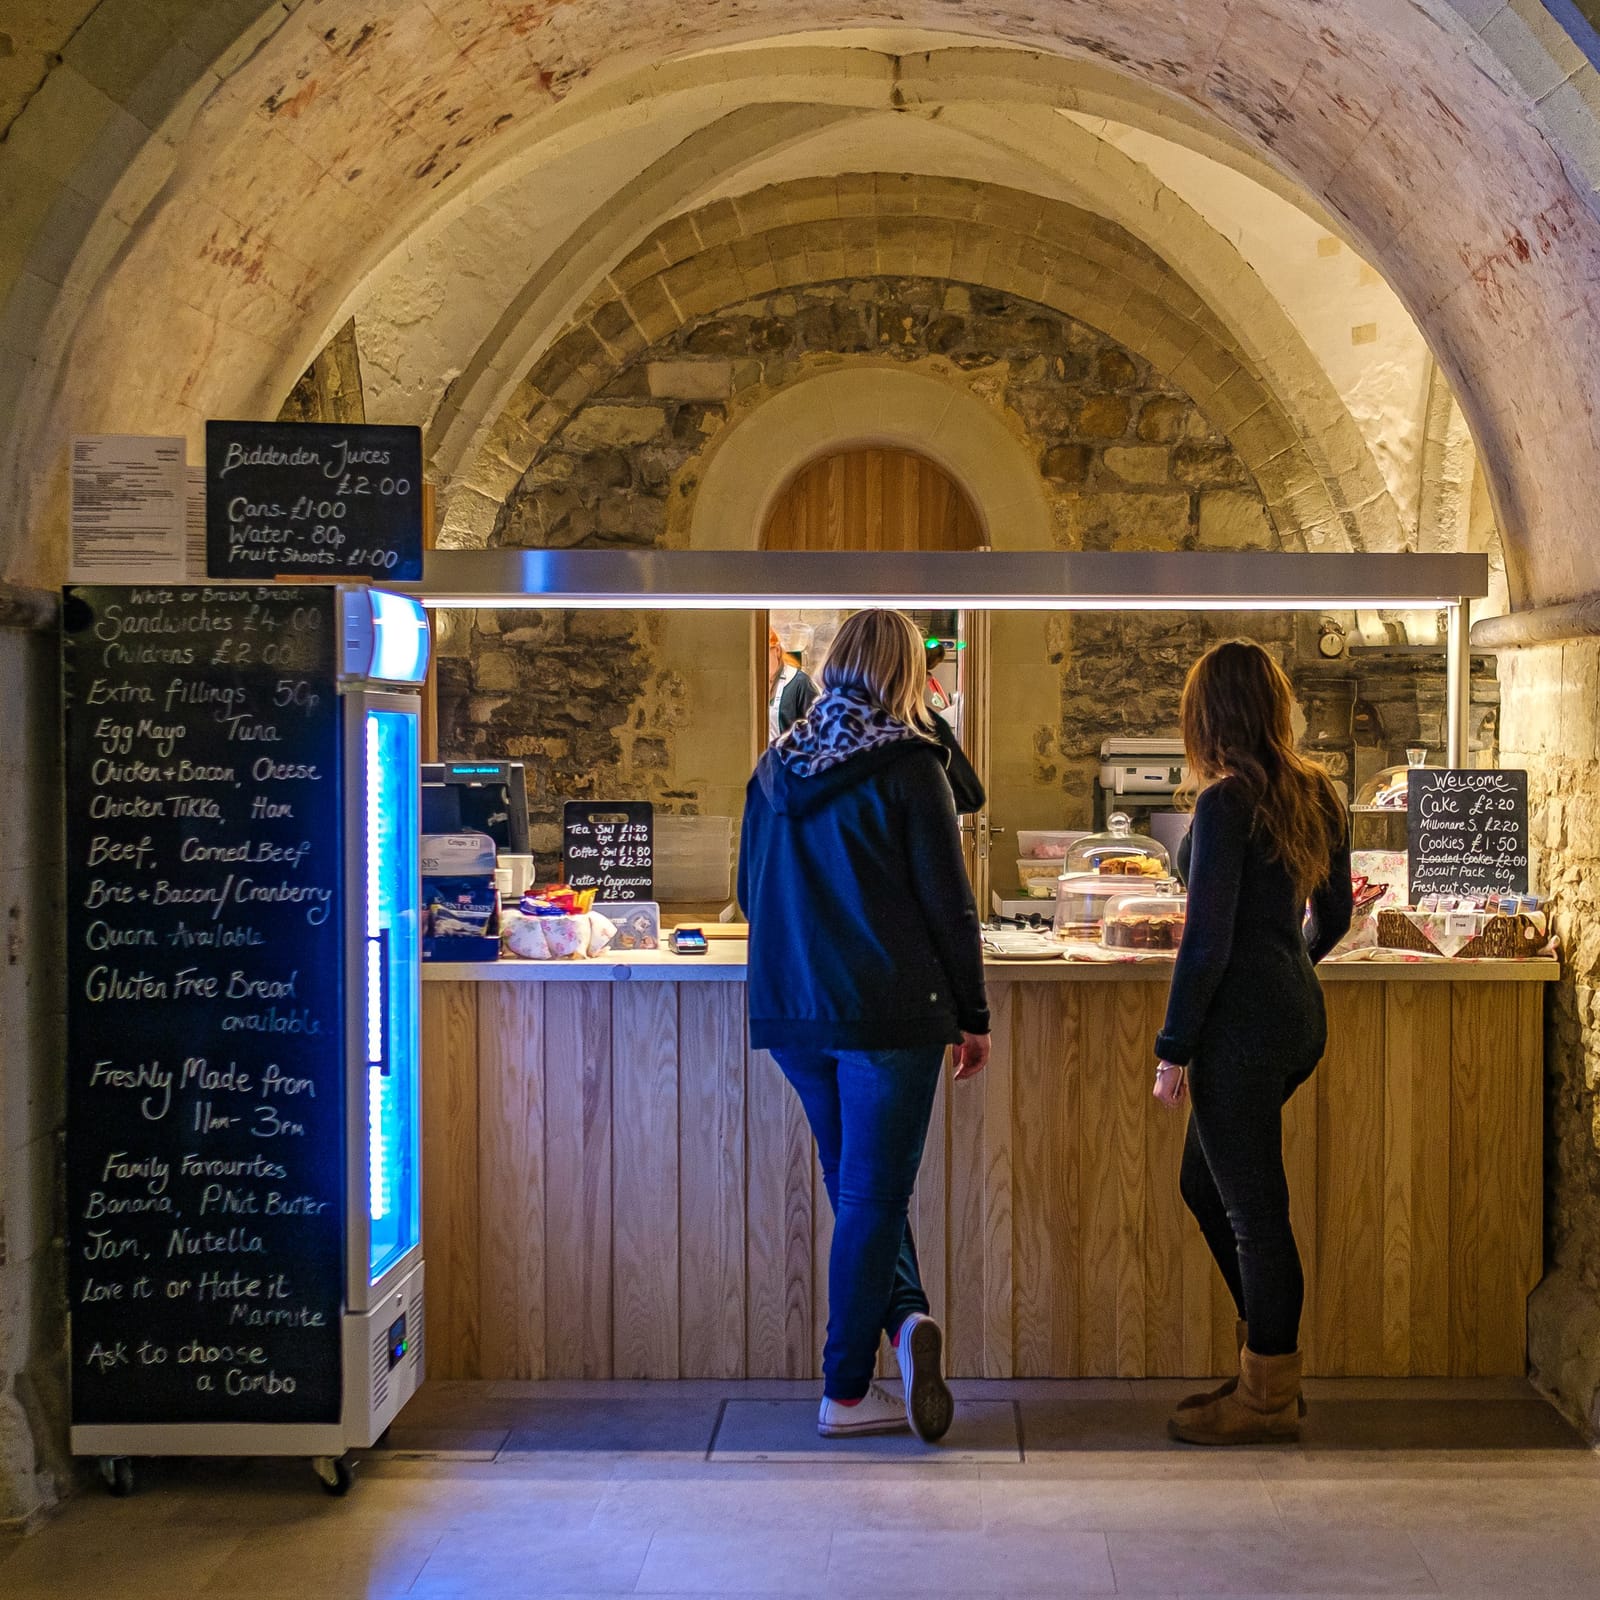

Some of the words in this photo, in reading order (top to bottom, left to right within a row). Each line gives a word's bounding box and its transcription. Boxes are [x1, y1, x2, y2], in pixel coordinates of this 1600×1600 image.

[220, 443, 320, 478] Biddenden
[323, 440, 391, 479] Juices
[229, 525, 294, 544] Water
[311, 525, 346, 549] 80p
[229, 545, 279, 563] Fruit
[131, 588, 174, 604] White
[181, 592, 198, 602] or
[202, 588, 252, 602] Brown
[94, 605, 233, 641] Sandwiches
[103, 643, 194, 669] Childrens
[86, 679, 156, 705] Extra
[165, 678, 247, 722] fillings
[273, 680, 320, 716] 50p
[94, 718, 135, 754] Egg
[136, 719, 186, 758] Mayo
[226, 714, 281, 741] Tuna
[252, 757, 323, 782] Cheese
[89, 795, 166, 819] Chicken
[251, 796, 294, 818] Ham
[1420, 793, 1460, 818] Cake
[566, 823, 591, 835] Tea
[596, 834, 614, 845] Lge
[180, 837, 250, 863] Corned
[253, 841, 312, 868] Beef
[569, 846, 600, 858] Coffee
[1419, 833, 1465, 853] Cookies
[599, 857, 616, 871] Lge
[1415, 865, 1457, 878] Biscuit
[1459, 866, 1486, 878] Pack
[84, 879, 135, 909] Brie
[1411, 881, 1438, 893] Fresh
[1439, 881, 1459, 895] cut
[86, 921, 158, 951] Quorn
[167, 921, 265, 948] Available
[86, 966, 167, 1002] Gluten
[172, 967, 218, 999] Free
[226, 970, 298, 999] Bread
[221, 1006, 321, 1034] available
[90, 1060, 173, 1120] Freshly
[180, 1057, 253, 1091] Made
[261, 1064, 316, 1098] from
[102, 1151, 170, 1195] Family
[181, 1153, 287, 1178] Favourites
[264, 1191, 329, 1215] Butter
[167, 1227, 265, 1258] Nutella
[81, 1278, 123, 1303] Love
[133, 1276, 153, 1299] it
[166, 1280, 192, 1299] or
[198, 1271, 262, 1301] Hate
[268, 1274, 293, 1299] it
[229, 1304, 326, 1327] Marmite
[86, 1341, 129, 1375] Ask
[136, 1341, 168, 1365] to
[177, 1340, 268, 1364] choose
[196, 1374, 216, 1392] a
[225, 1369, 297, 1396] Combo
